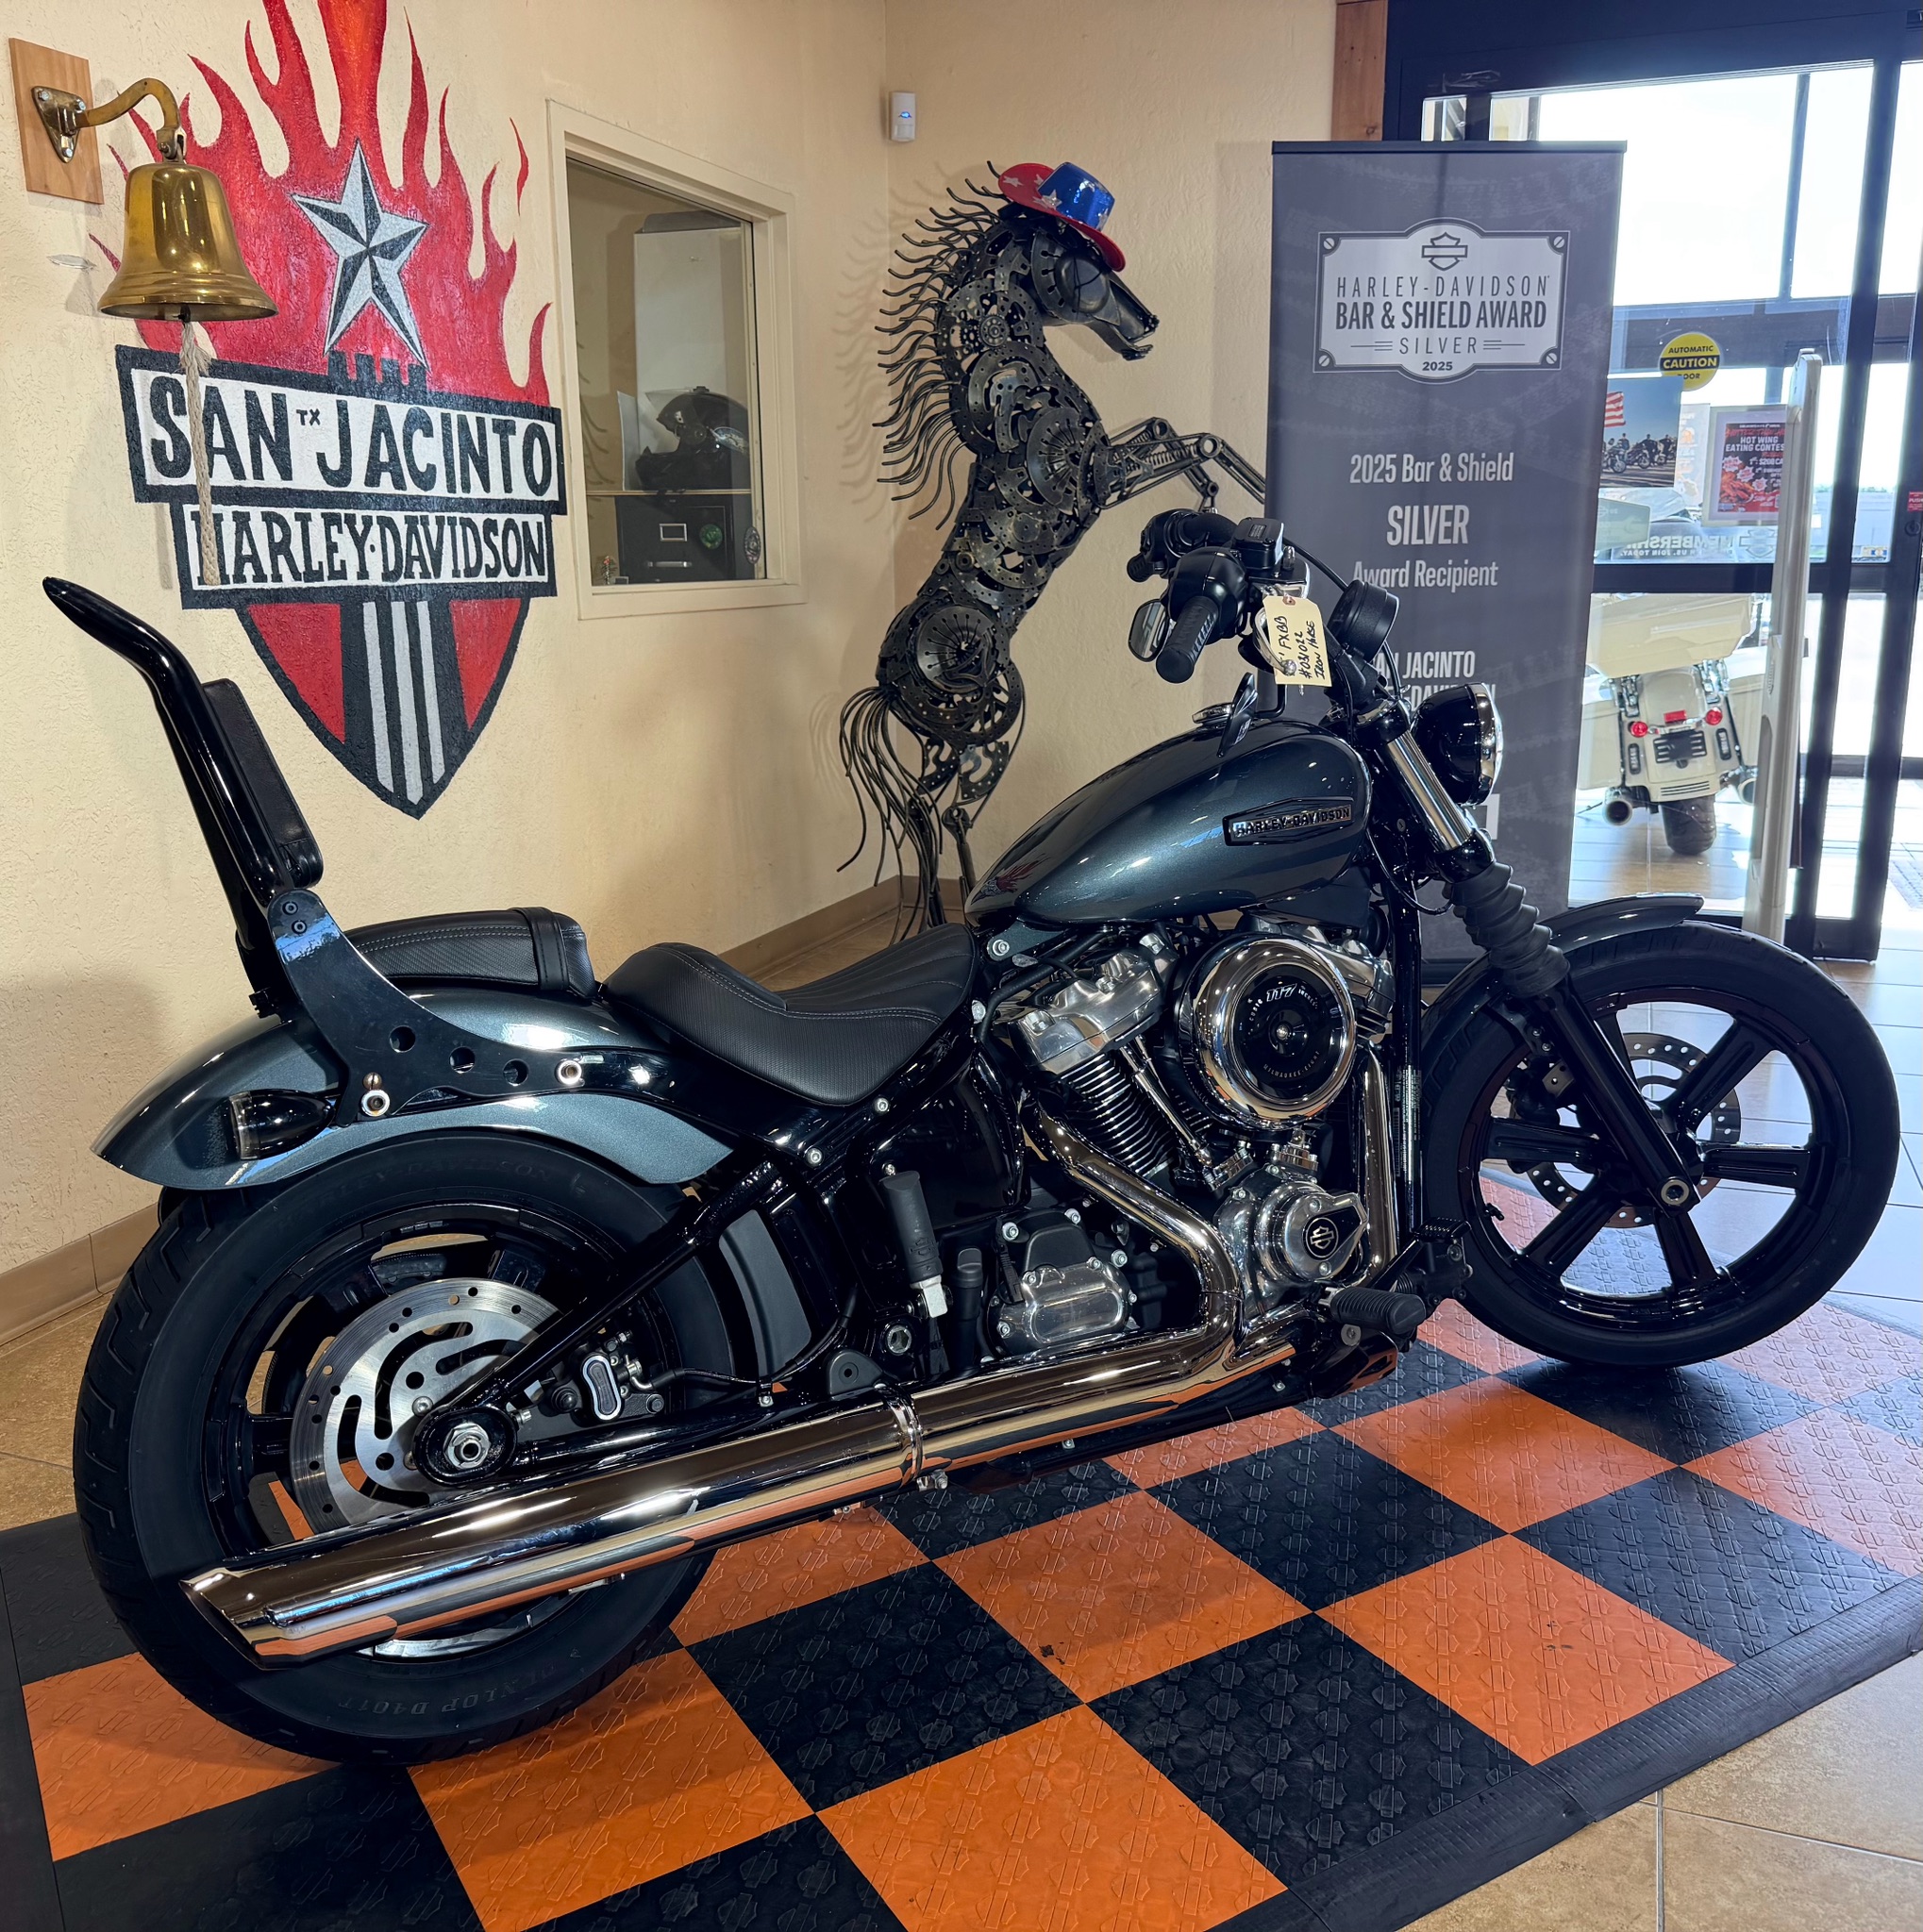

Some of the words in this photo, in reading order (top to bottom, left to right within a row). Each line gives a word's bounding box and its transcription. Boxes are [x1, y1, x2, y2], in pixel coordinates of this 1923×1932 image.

[1337, 275, 1547, 298] HARLEY-DAVIDSON
[1335, 301, 1374, 330] BAR
[1380, 301, 1396, 329] &
[1401, 300, 1472, 329] SHIELD
[1476, 300, 1547, 328] AWARD
[1399, 337, 1478, 354] SILVER
[1668, 345, 1714, 354] AUTOMATIC
[1422, 361, 1453, 372] 2025
[1663, 358, 1717, 369] CAUTION
[150, 375, 293, 482] SAN
[296, 408, 321, 426] TX
[316, 400, 551, 497] JACINTO
[1725, 443, 1754, 452] EATING
[1755, 443, 1784, 452] CONTES
[1740, 436, 1756, 444] HOT
[1757, 436, 1779, 444] WING
[1349, 454, 1397, 484] 2025
[1401, 453, 1434, 483] Bar
[1438, 452, 1453, 483] &
[1457, 452, 1514, 482] Shield
[1386, 505, 1470, 546] SILVER
[1353, 560, 1410, 588] Award
[1414, 560, 1498, 593] Recipient
[1402, 650, 1476, 679] JACINTO
[1234, 808, 1350, 837] HARLEY-DAVIDSON
